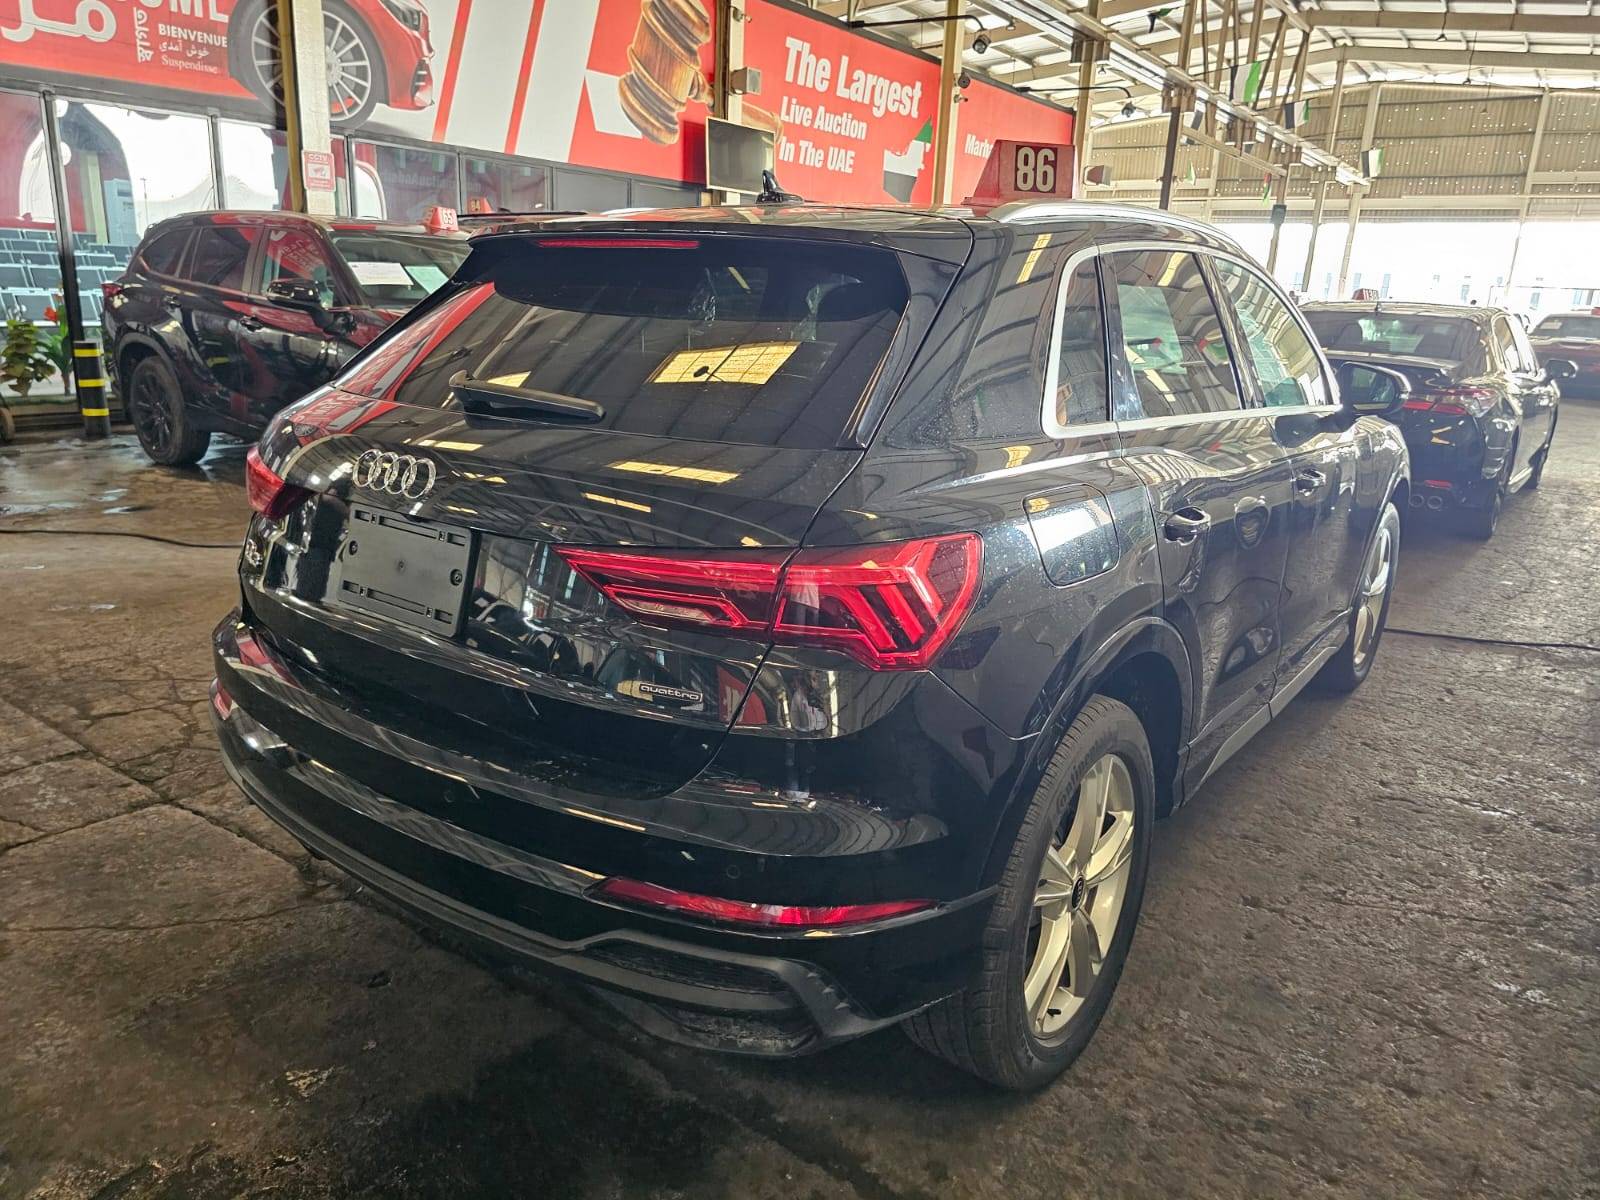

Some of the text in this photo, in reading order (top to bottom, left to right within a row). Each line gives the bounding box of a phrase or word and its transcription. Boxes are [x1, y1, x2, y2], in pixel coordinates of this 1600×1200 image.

[158, 23, 228, 48] BIENVENUE
[785, 36, 922, 118] The Largest
[780, 96, 867, 140] Live Auction
[778, 136, 856, 174] In The UAE
[1016, 146, 1056, 192] 86
[640, 685, 699, 700] quattro
